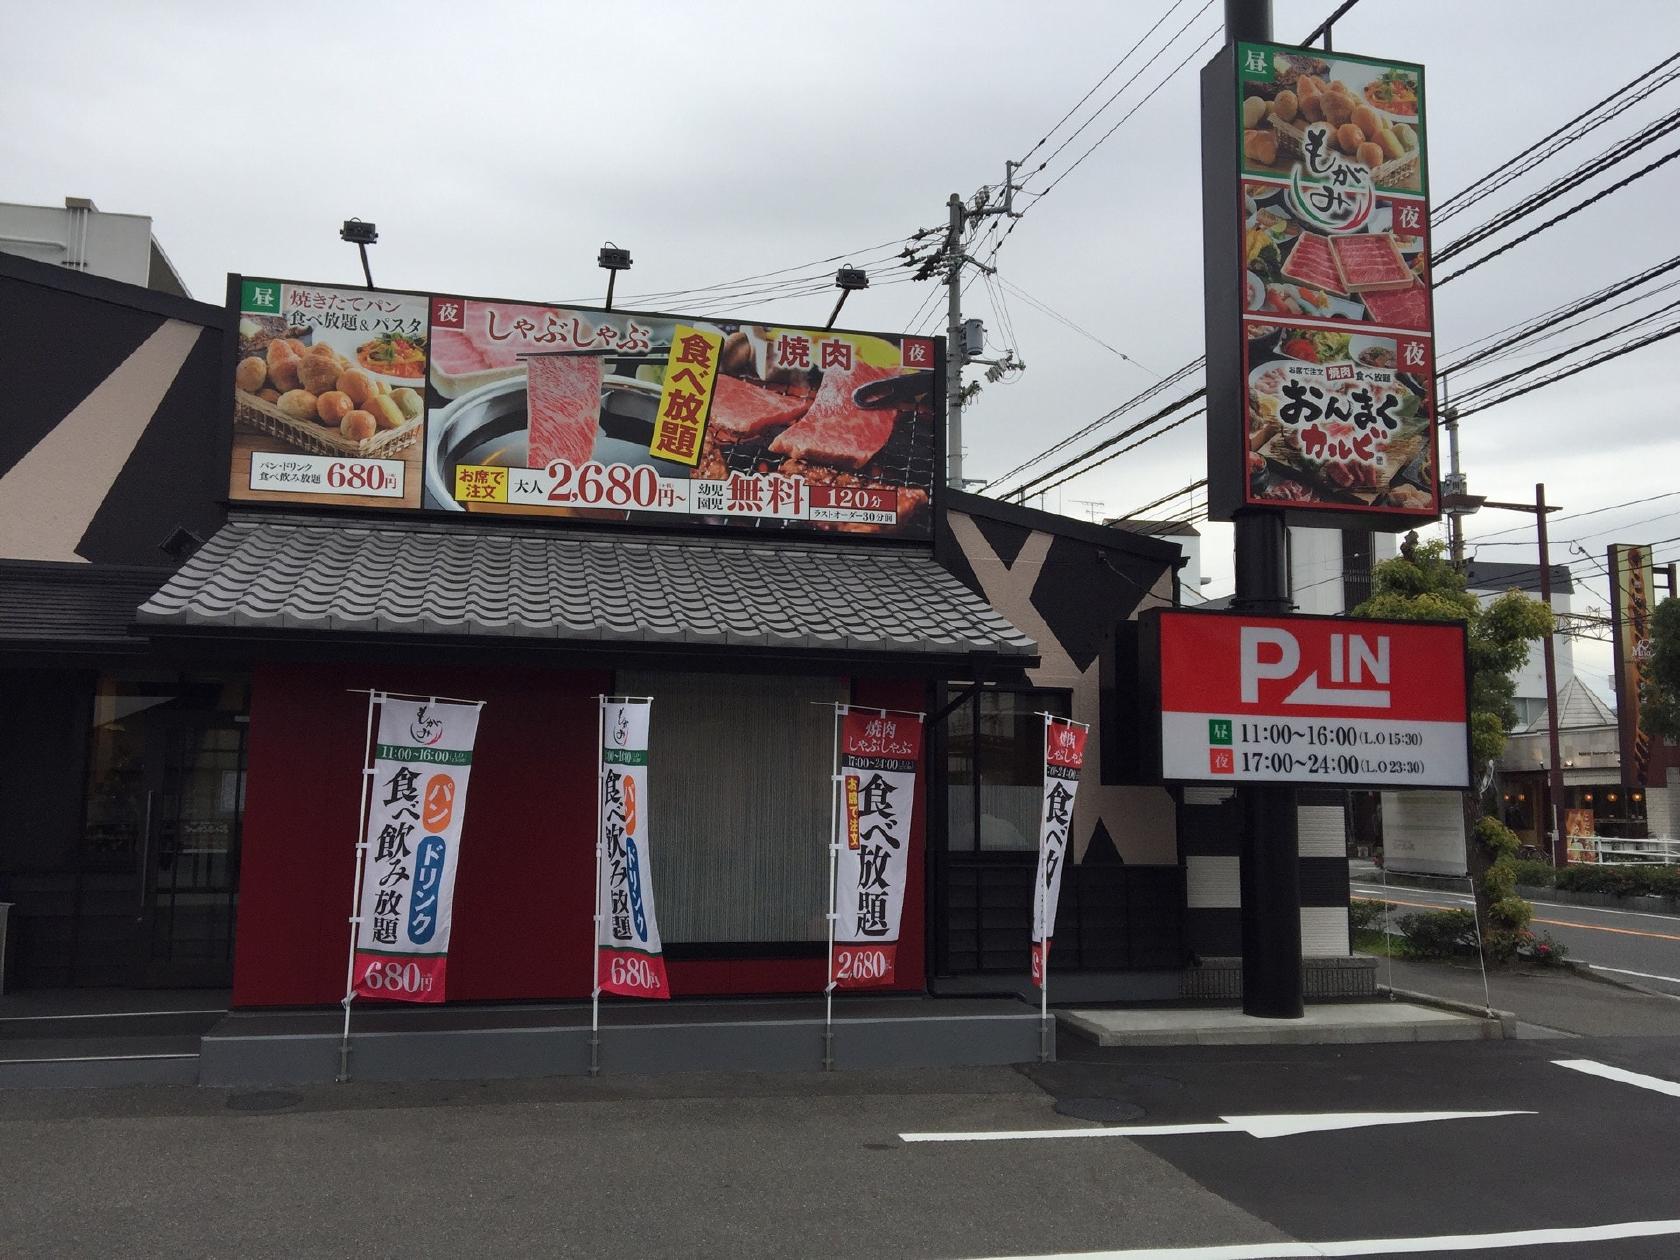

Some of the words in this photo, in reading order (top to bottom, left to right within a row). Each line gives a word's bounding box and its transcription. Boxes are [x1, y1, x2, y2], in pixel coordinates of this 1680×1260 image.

[1245, 50, 1268, 74] 昼
[1305, 128, 1369, 213] もがみ
[1399, 206, 1421, 229] 夜
[252, 287, 275, 308] 昼
[290, 290, 402, 313] 焼きたてパン
[438, 303, 460, 323] 夜
[487, 310, 651, 351] しゃぶしゃぶ
[777, 334, 853, 371] 焼肉
[908, 344, 928, 364] 夜
[1403, 341, 1426, 367] 夜
[1355, 370, 1392, 383] 食べ放題
[655, 332, 715, 459] 食べ放題
[1279, 379, 1399, 431] おんまく
[1300, 423, 1388, 461] カルビ
[258, 471, 322, 485] 食べ飲み放題
[458, 469, 505, 486] お席で
[514, 479, 544, 495] 大人
[466, 484, 497, 500] 注文
[698, 484, 724, 497] 幼児
[726, 473, 804, 515] 無料
[827, 489, 883, 508] 120分
[1240, 626, 1301, 704] P
[1330, 633, 1391, 684] IN
[865, 719, 897, 738] 焼肉
[1214, 724, 1229, 739] 昼
[849, 735, 913, 754] しゃぶしゃぶ
[1215, 754, 1230, 769] 夜
[427, 782, 453, 824] パン
[371, 766, 423, 945] 食べ飲み放題
[605, 768, 633, 940] 食べ飲み放題
[855, 772, 901, 938] 食べ放題
[411, 843, 444, 936] ドリンク
